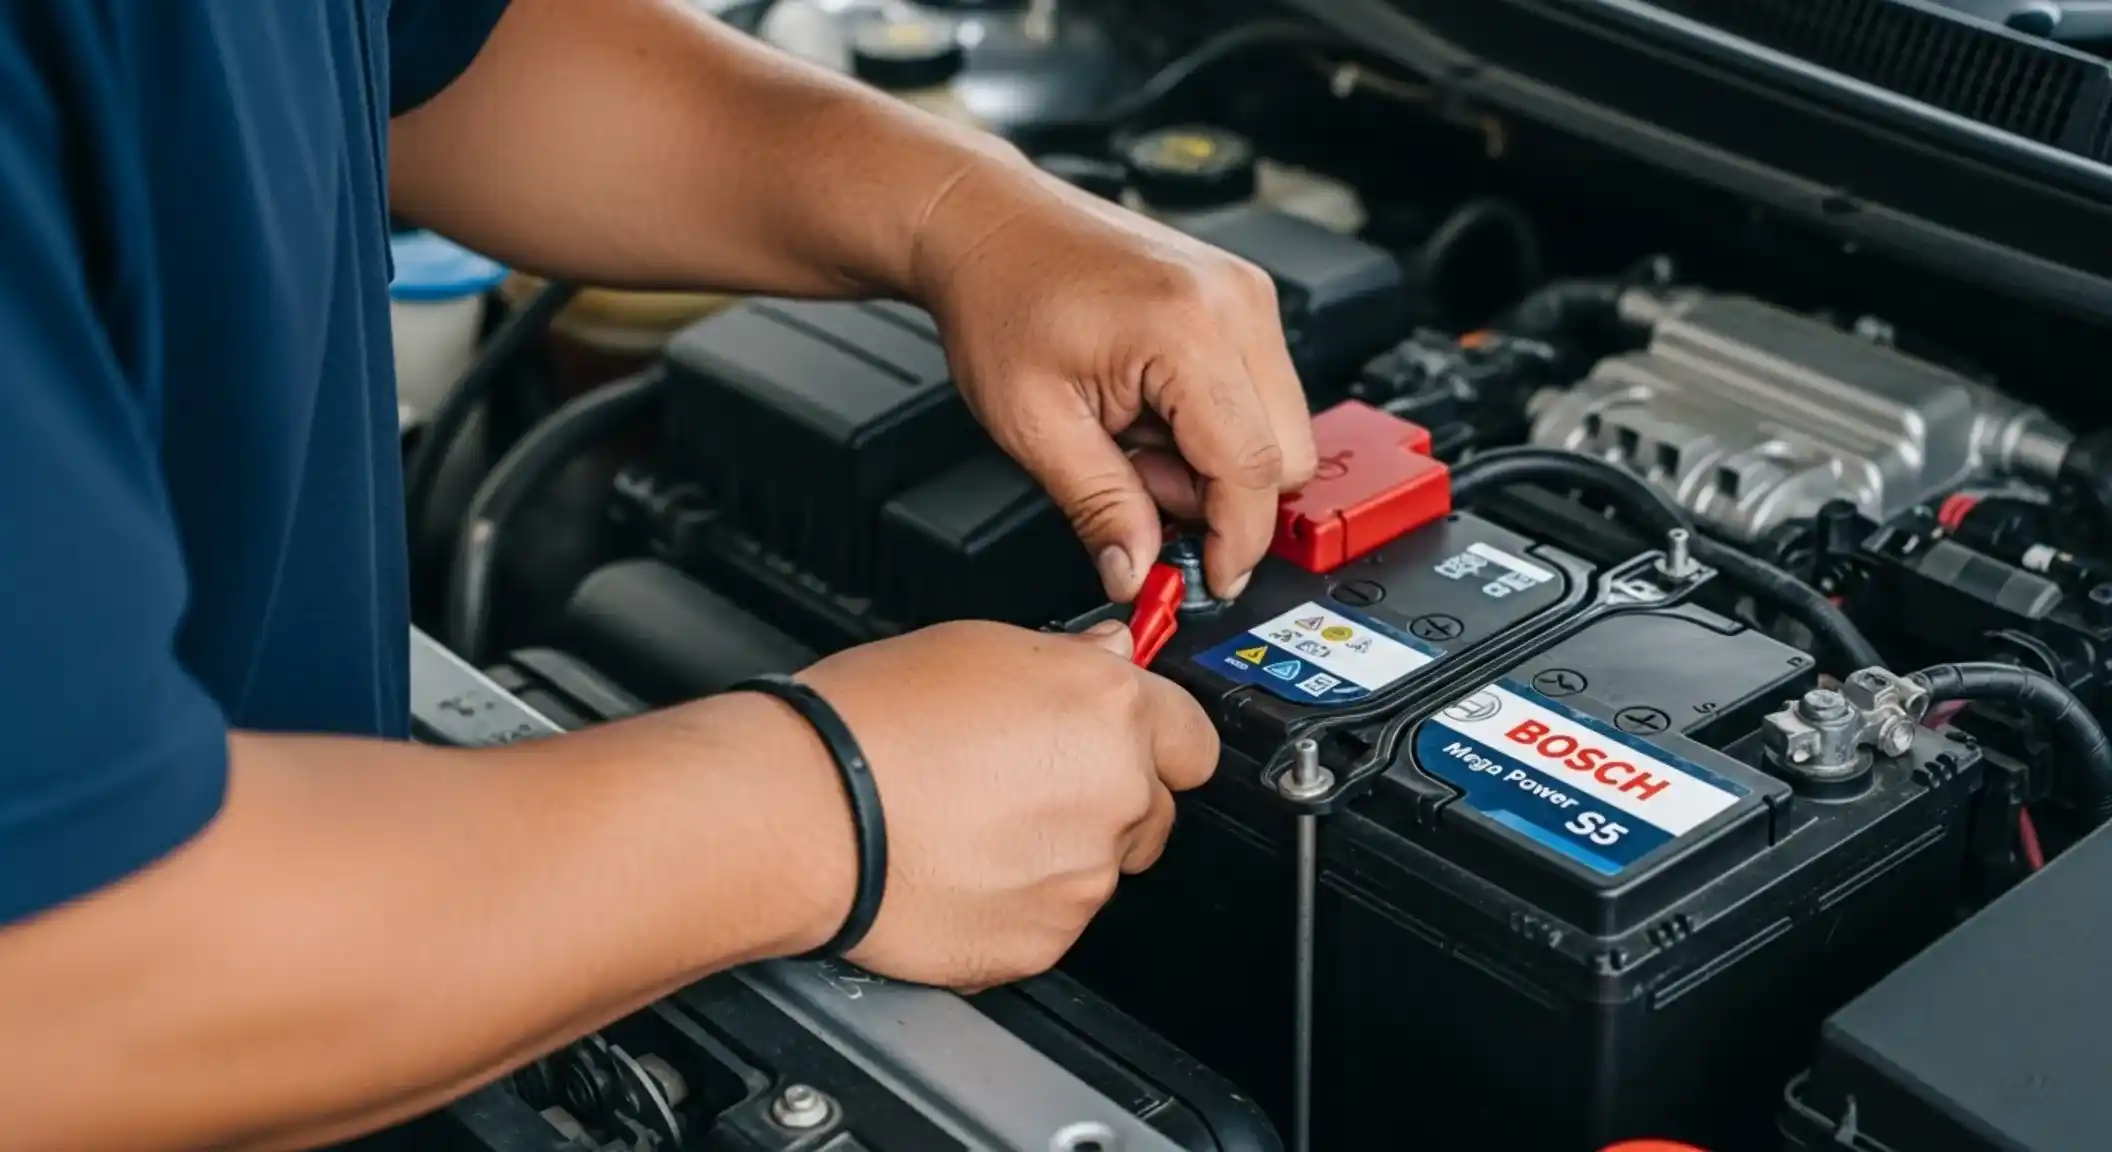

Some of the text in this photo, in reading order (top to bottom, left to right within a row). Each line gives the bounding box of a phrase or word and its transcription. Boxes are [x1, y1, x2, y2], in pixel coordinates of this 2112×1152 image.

[1504, 719, 1671, 801] BOSCH
[1503, 769, 1580, 809] Power
[1564, 811, 1629, 845] S5
